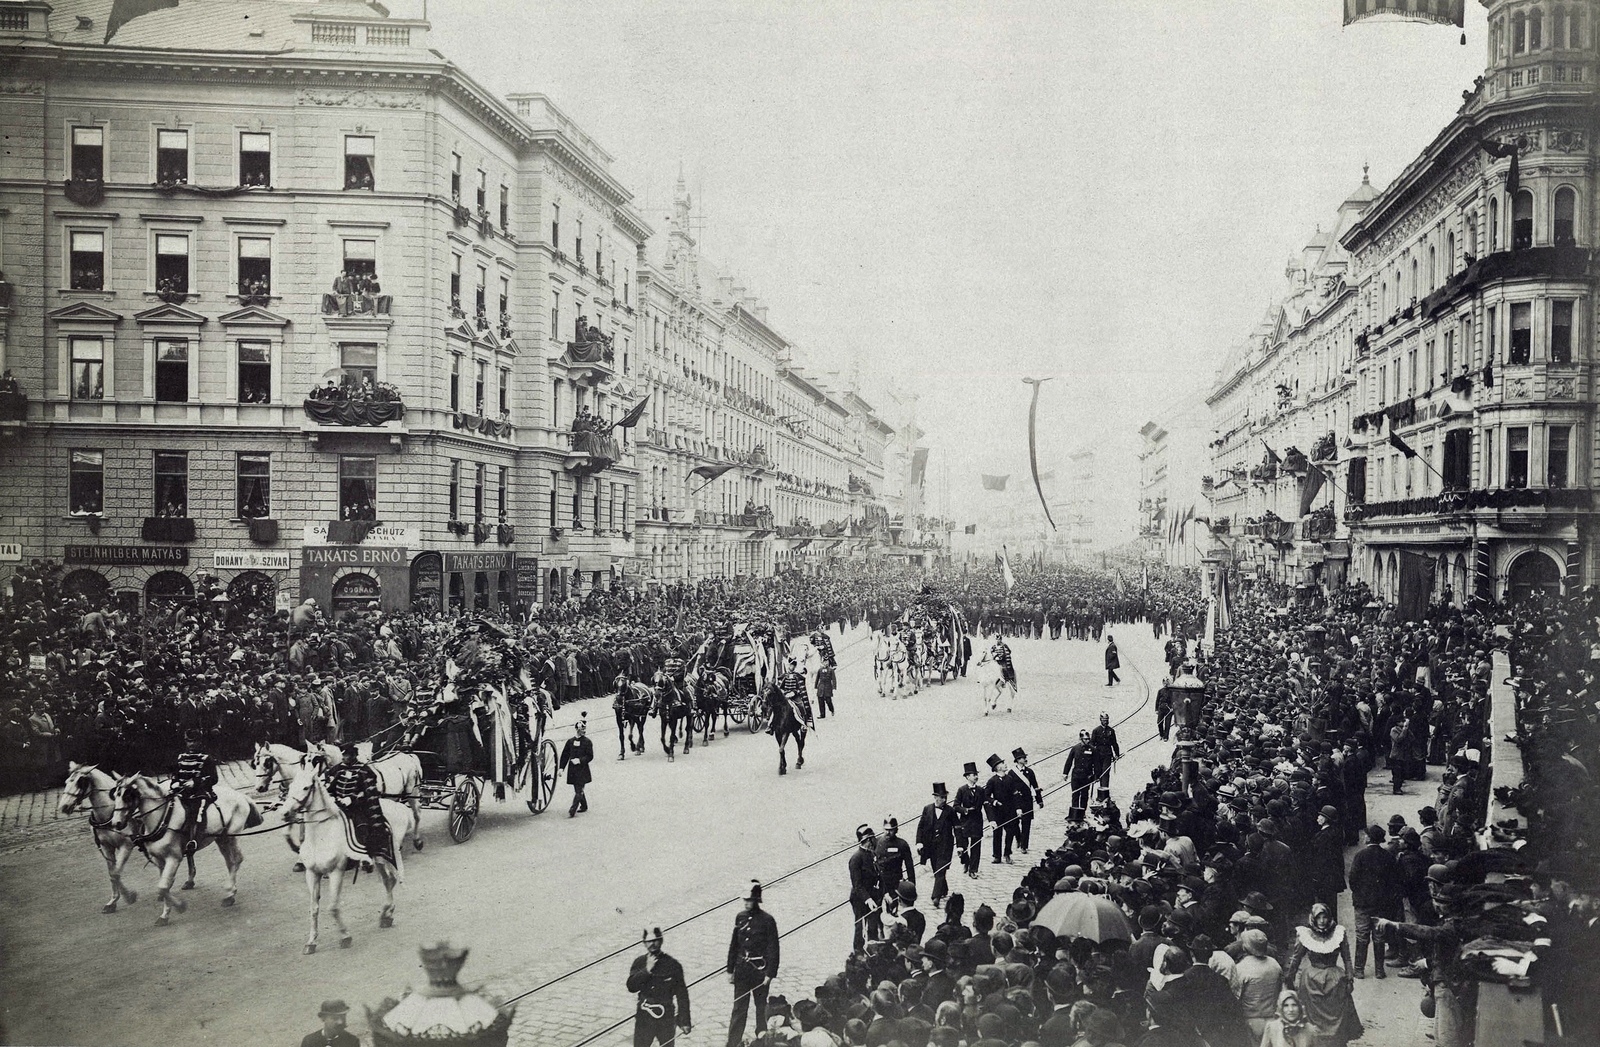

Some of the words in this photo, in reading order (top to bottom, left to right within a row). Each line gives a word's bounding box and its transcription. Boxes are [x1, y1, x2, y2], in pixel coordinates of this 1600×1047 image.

[71, 547, 139, 559] STEINHILBER
[307, 548, 358, 562] TAKÁTS
[262, 556, 288, 567] SZIVAR
[453, 554, 483, 569] TAKÁTS
